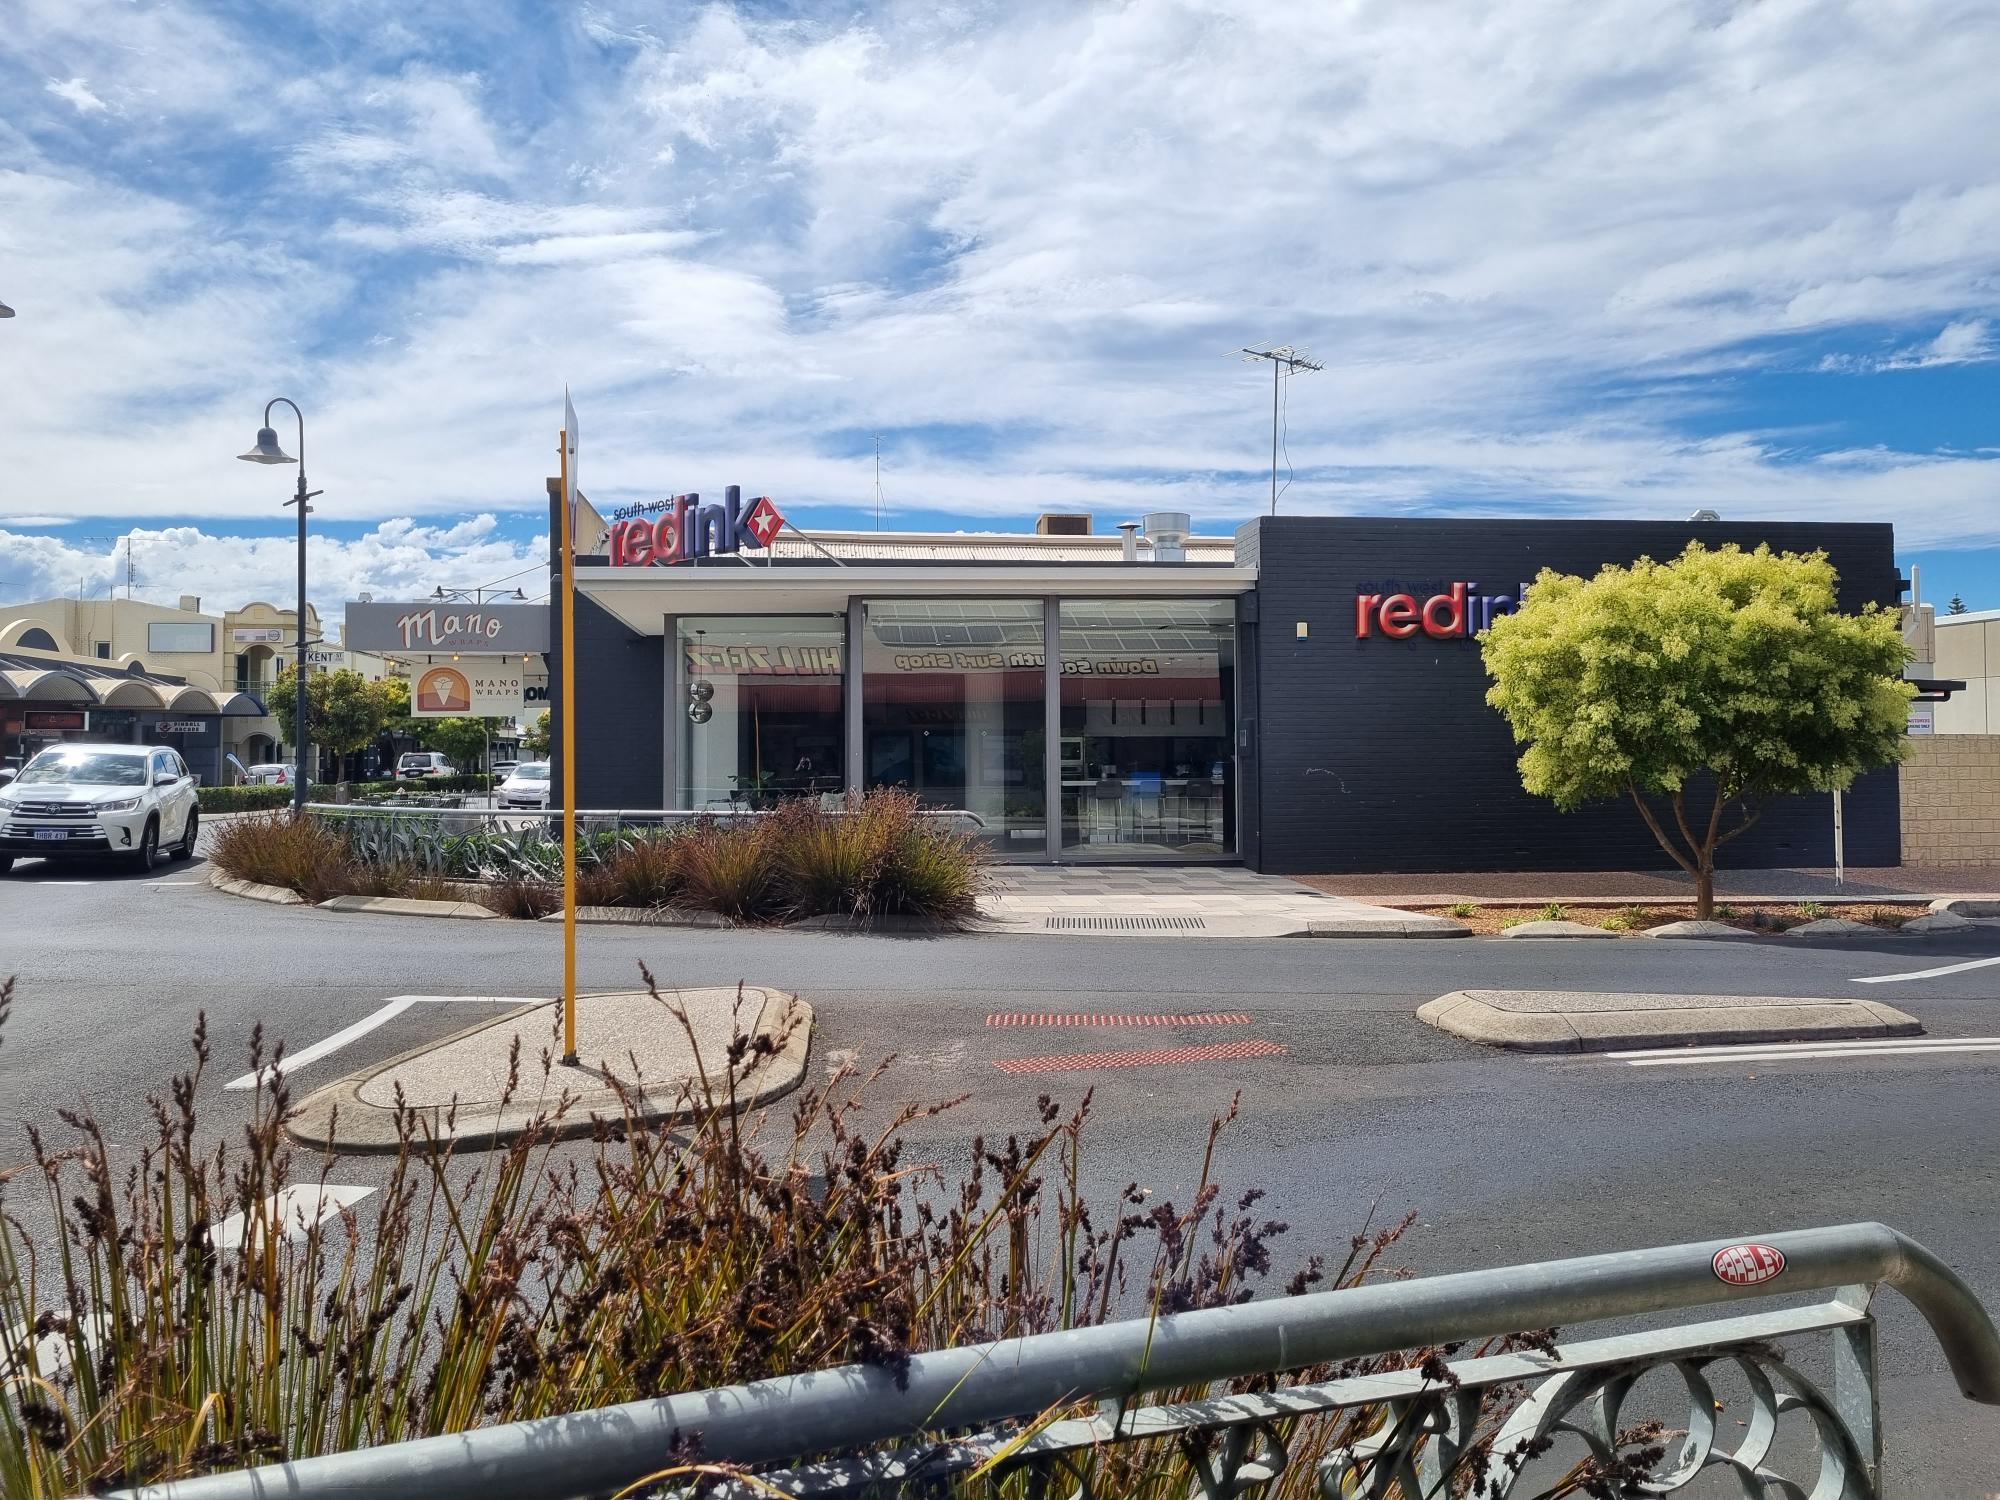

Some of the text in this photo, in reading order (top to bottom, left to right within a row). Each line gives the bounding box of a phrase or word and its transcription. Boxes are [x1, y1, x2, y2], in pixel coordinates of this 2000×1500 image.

[1356, 578, 1444, 593] south west
[1355, 581, 1529, 640] redin
[448, 639, 489, 647] WRAPS
[308, 652, 333, 662] KENT
[475, 679, 519, 687] MANO
